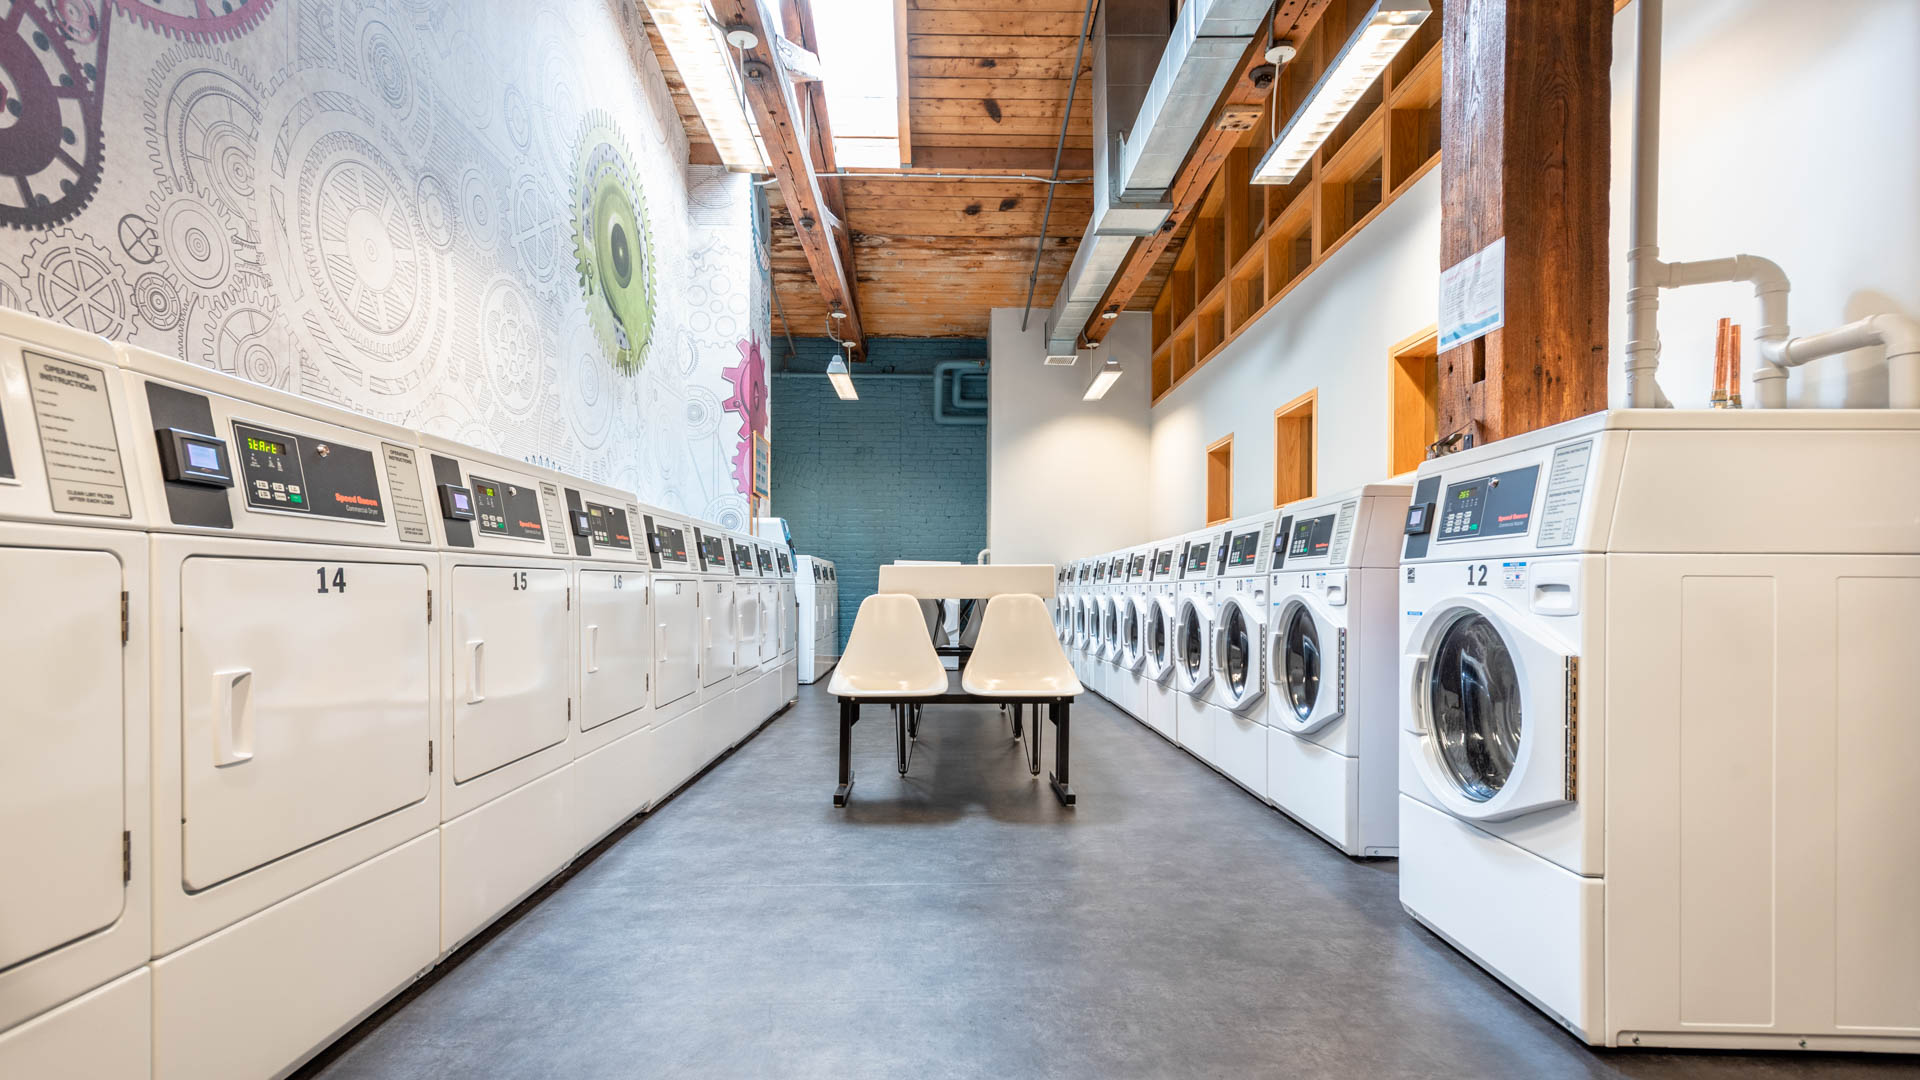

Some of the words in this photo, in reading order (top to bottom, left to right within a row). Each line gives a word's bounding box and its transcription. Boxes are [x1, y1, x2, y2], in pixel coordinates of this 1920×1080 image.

[43, 364, 90, 381] OPERATING
[39, 373, 97, 392] INSTRUCTIONS
[67, 489, 85, 497] CLEAN
[335, 492, 357, 504] Speed
[357, 495, 378, 507] Queen
[316, 566, 347, 594] 14
[513, 572, 528, 591] 15
[613, 574, 622, 590] 16
[1301, 574, 1310, 589] 11
[1467, 564, 1488, 587] 12
